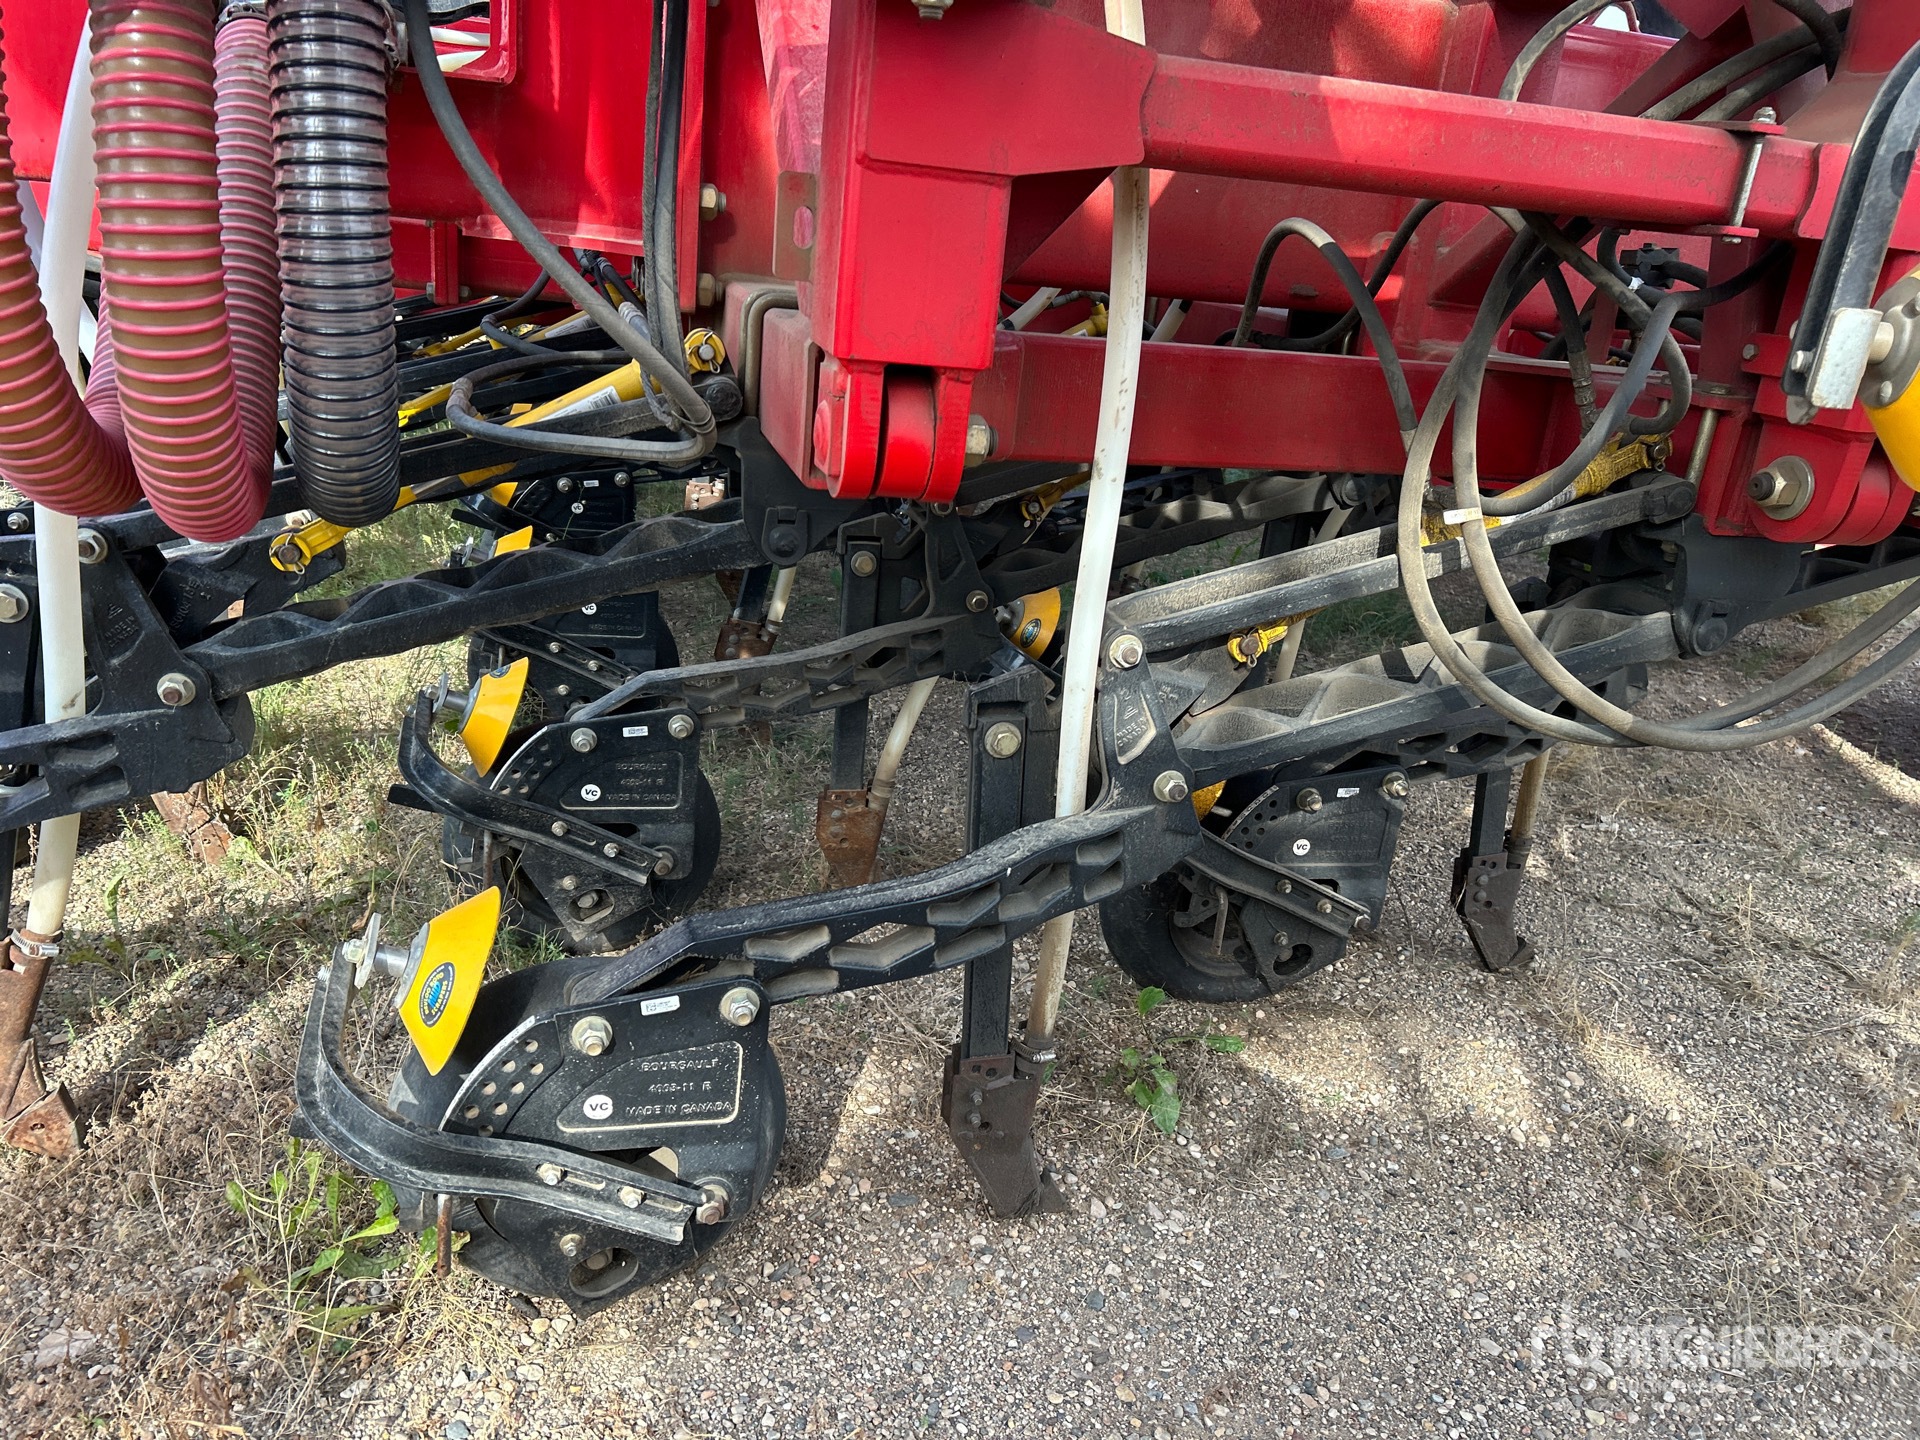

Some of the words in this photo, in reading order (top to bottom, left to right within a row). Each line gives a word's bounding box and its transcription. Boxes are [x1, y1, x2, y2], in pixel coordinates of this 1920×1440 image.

[1116, 722, 1138, 737] MADE
[1117, 724, 1147, 747] CANADA
[643, 793, 677, 801] CANADA
[1296, 843, 1308, 851] VC
[431, 980, 448, 1016] SCRAPERS
[641, 1058, 718, 1072] BOURGAULT
[589, 1102, 609, 1111] VC
[626, 1105, 661, 1117] MADE
[665, 1104, 677, 1114] IN
[680, 1101, 733, 1115] CANADA
